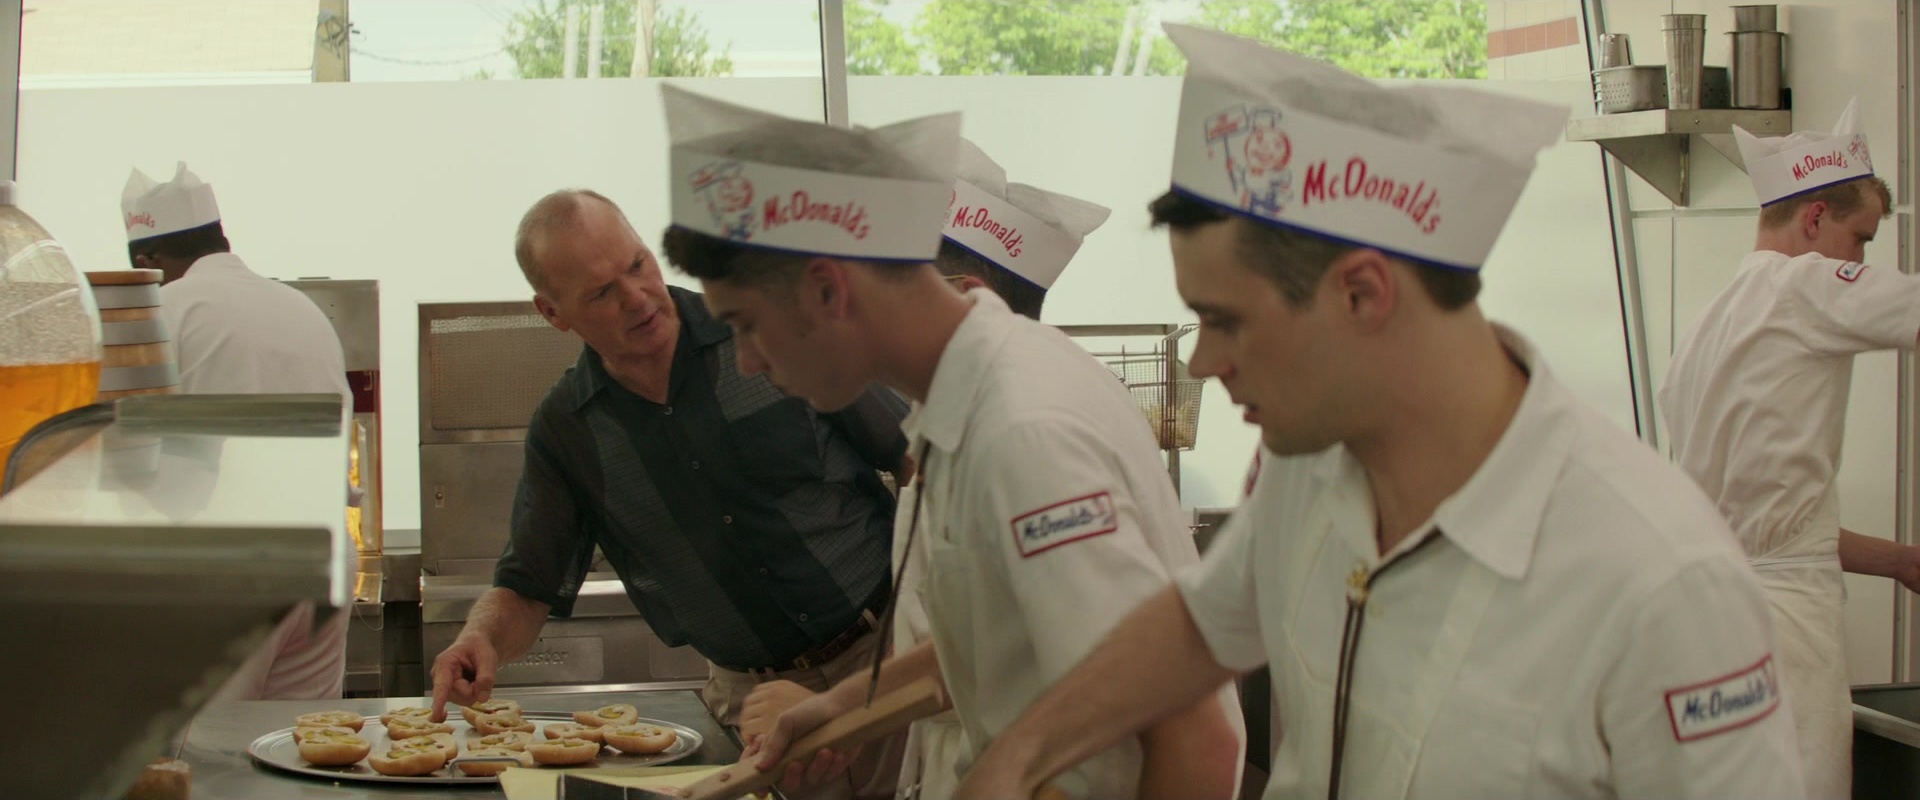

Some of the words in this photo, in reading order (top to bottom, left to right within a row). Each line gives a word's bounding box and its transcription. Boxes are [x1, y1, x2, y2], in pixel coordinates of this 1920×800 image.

[1792, 150, 1849, 181] McDonald's
[763, 190, 871, 240] McDonald's
[1303, 157, 1441, 235] McDonald's
[952, 206, 1023, 258] McDonald's
